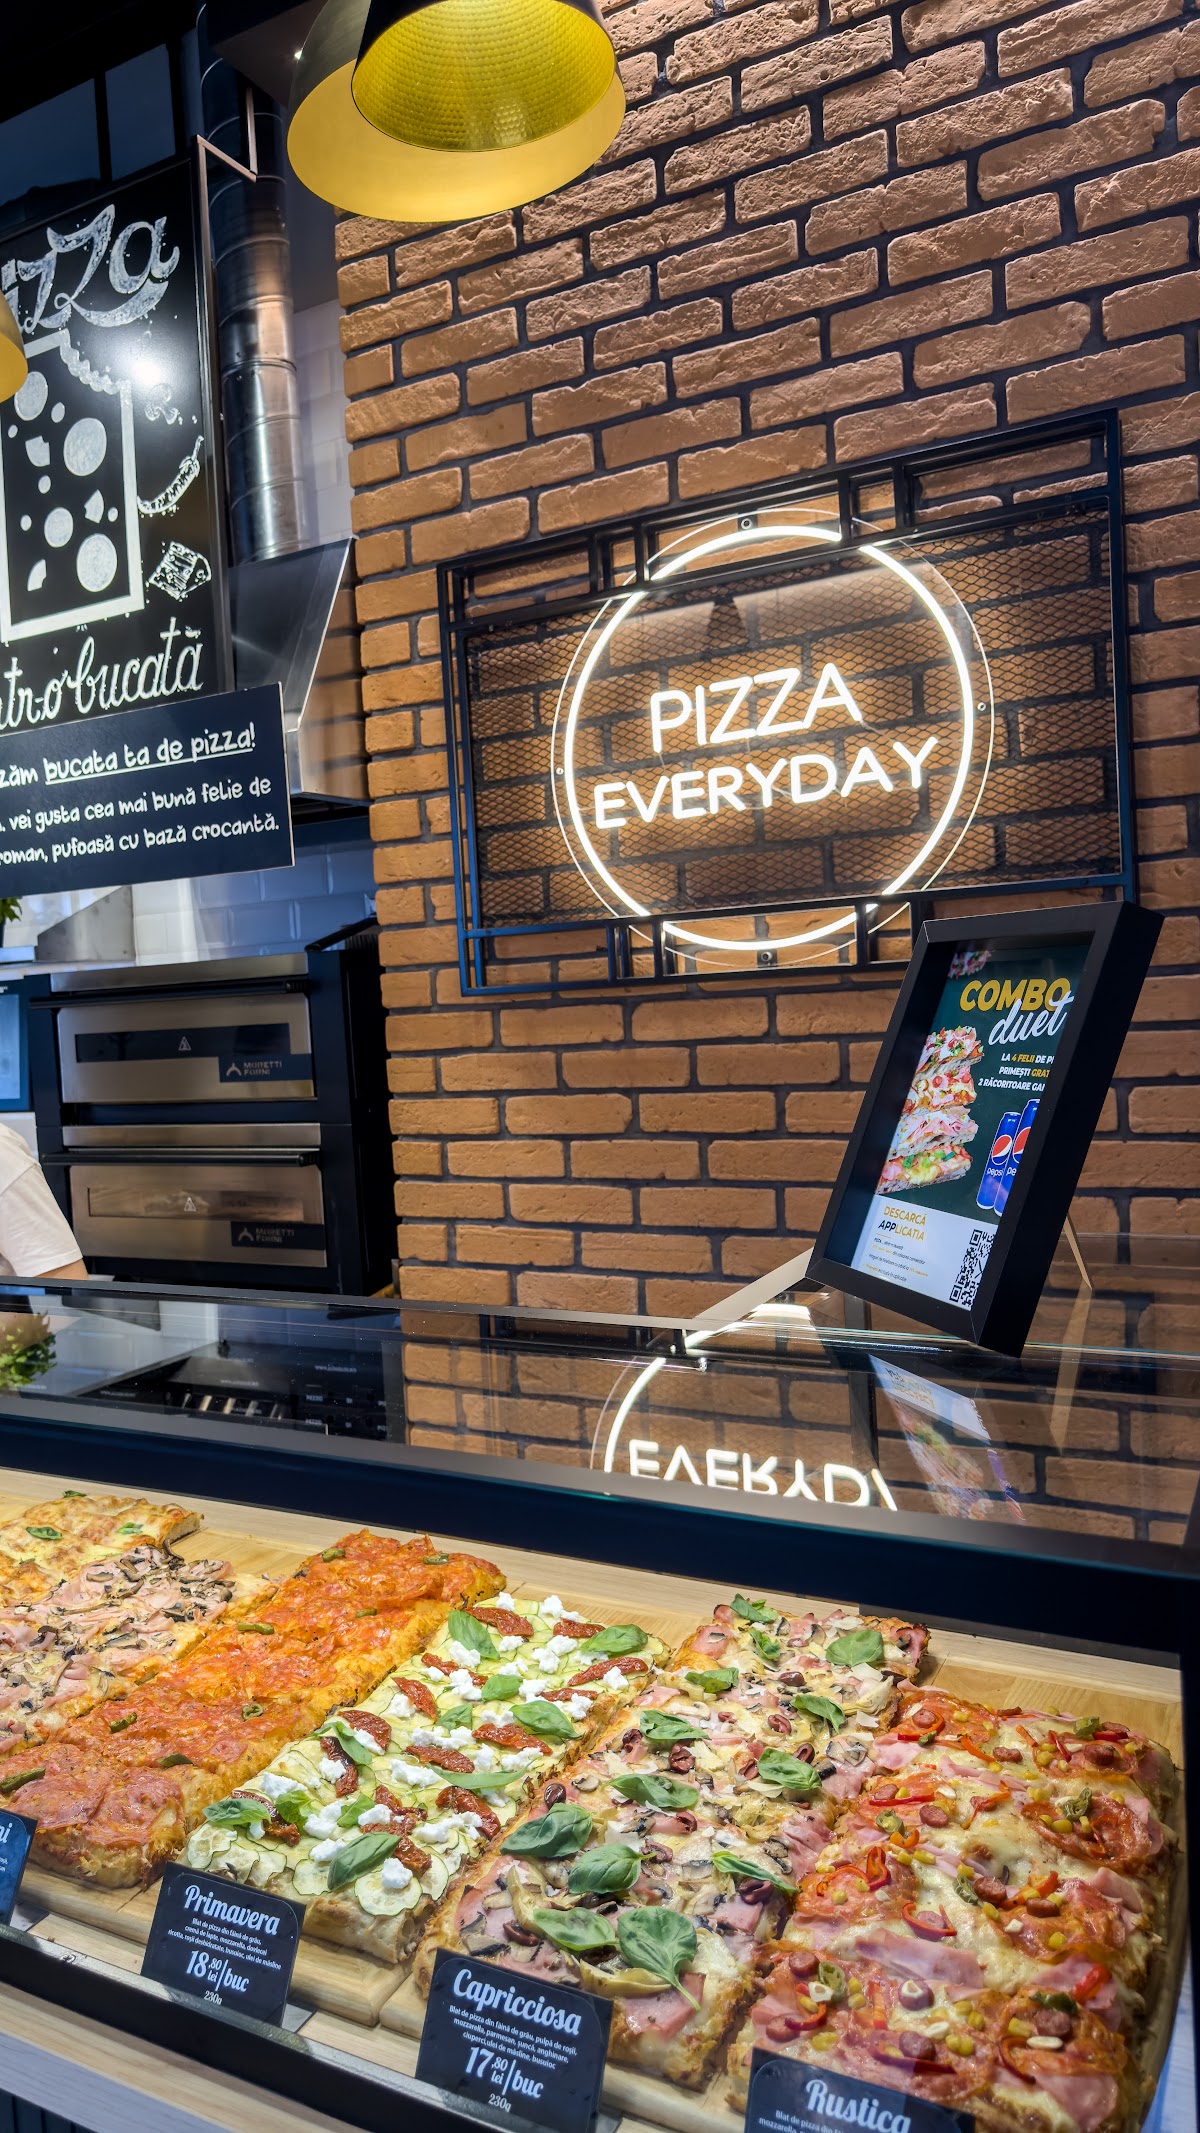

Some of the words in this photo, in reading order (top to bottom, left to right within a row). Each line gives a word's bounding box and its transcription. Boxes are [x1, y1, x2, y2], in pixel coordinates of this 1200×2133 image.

[74, 616, 204, 714] bucată
[649, 662, 863, 754] PIZZA
[43, 749, 118, 782] bucata
[124, 744, 150, 768] ta
[157, 737, 183, 763] de
[191, 721, 256, 763] pizza!
[8, 808, 32, 831] vei
[35, 804, 81, 834] gusta
[84, 802, 115, 821] cea
[118, 791, 149, 816] mai
[152, 787, 196, 812] bună
[202, 778, 244, 804] felie
[249, 776, 272, 798] de
[593, 736, 940, 829] EVERYDAY
[52, 835, 115, 863] pufoasă
[118, 832, 140, 851] cu
[143, 825, 187, 848] bază
[191, 812, 280, 839] crocantă.
[959, 977, 1072, 1012] COMBO
[987, 990, 1075, 1046] duet
[998, 1066, 1032, 1079] PRIMEȘTI
[1001, 1053, 1011, 1062] LA
[1011, 1053, 1018, 1062] 4
[1017, 1053, 1036, 1063] FELII
[1035, 1054, 1047, 1064] DE
[978, 1078, 984, 1086] 2
[983, 1077, 1032, 1091] RĂCORITOARE
[184, 1884, 281, 1936] Primavera
[202, 1921, 209, 1929] de
[208, 1922, 221, 1933] pizza
[221, 1926, 230, 1936] din
[242, 1933, 250, 1942] de
[199, 1928, 207, 1937] de
[206, 1930, 219, 1942] lapte,
[219, 1937, 246, 1951] mozzarella,
[255, 1956, 263, 1964] de
[186, 1950, 210, 1978] 18
[207, 1970, 218, 1983] lei
[453, 1967, 583, 2036] Capricciosa
[449, 2004, 461, 2015] Blat
[461, 2009, 469, 2018] de
[469, 2012, 485, 2023] pizza
[484, 2017, 496, 2027] din
[495, 2019, 511, 2033] făină
[510, 2026, 519, 2036] de
[519, 2029, 535, 2042] grâu,
[535, 2035, 554, 2048] pulpă
[553, 2040, 562, 2050] de
[453, 2017, 486, 2034] mozzarella,
[485, 2028, 517, 2046] parmesan,
[517, 2040, 536, 2053] șuncă,
[536, 2047, 569, 2064] anghinare,
[465, 2046, 495, 2078] 17
[490, 2069, 505, 2085] lei
[498, 2043, 507, 2053] de
[506, 2047, 531, 2062] măsline,
[531, 2053, 557, 2070] busuioc
[775, 2109, 790, 2122] Blat
[790, 2115, 801, 2125] de
[800, 2119, 820, 2132] pizza
[805, 2078, 912, 2133] Rustica
